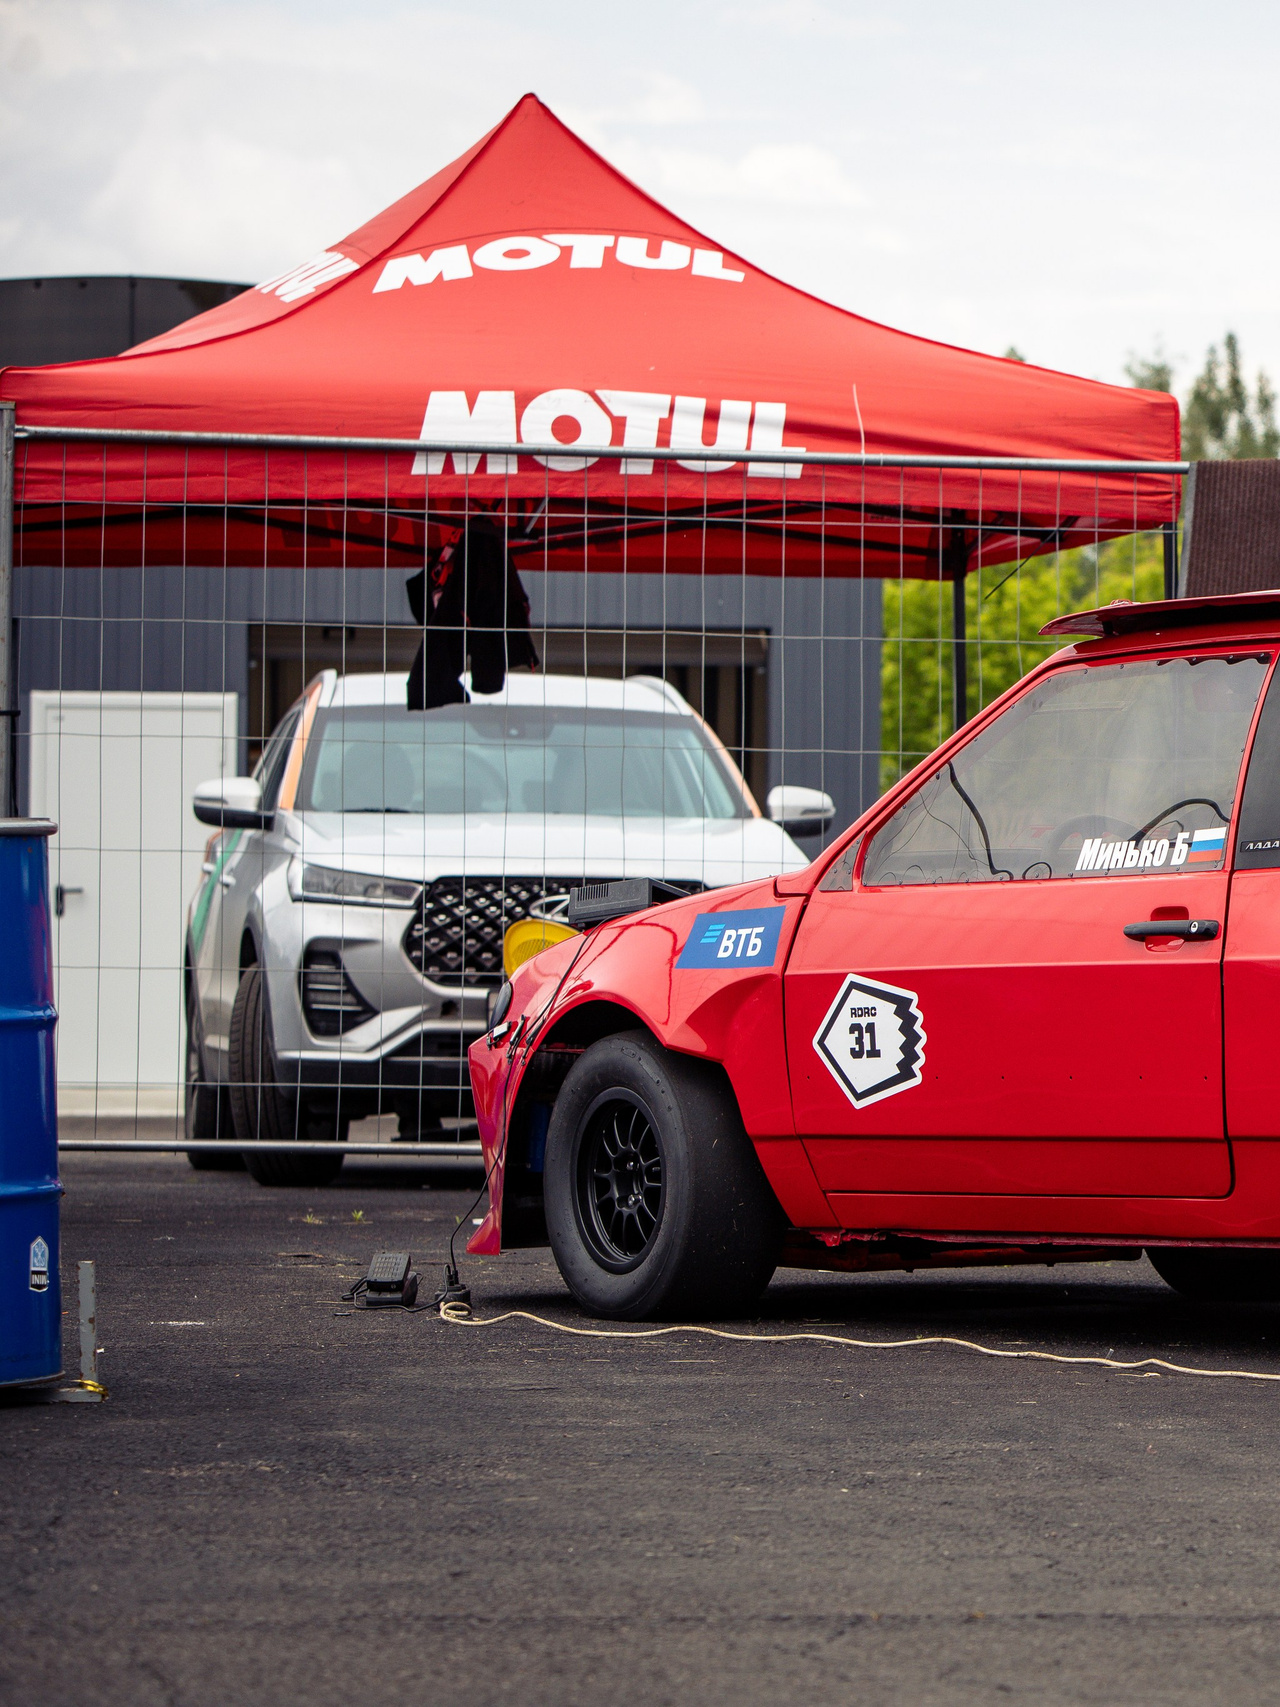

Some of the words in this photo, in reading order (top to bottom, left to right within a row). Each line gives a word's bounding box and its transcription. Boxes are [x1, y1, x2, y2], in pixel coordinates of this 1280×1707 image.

[372, 233, 746, 293] MOTUL
[411, 388, 807, 479] MOTUL
[1170, 832, 1190, 866] Б
[1245, 840, 1280, 850] ЛАДА
[716, 926, 765, 958] ВТБ
[850, 1006, 877, 1018] RDRC
[848, 1022, 881, 1059] 31
